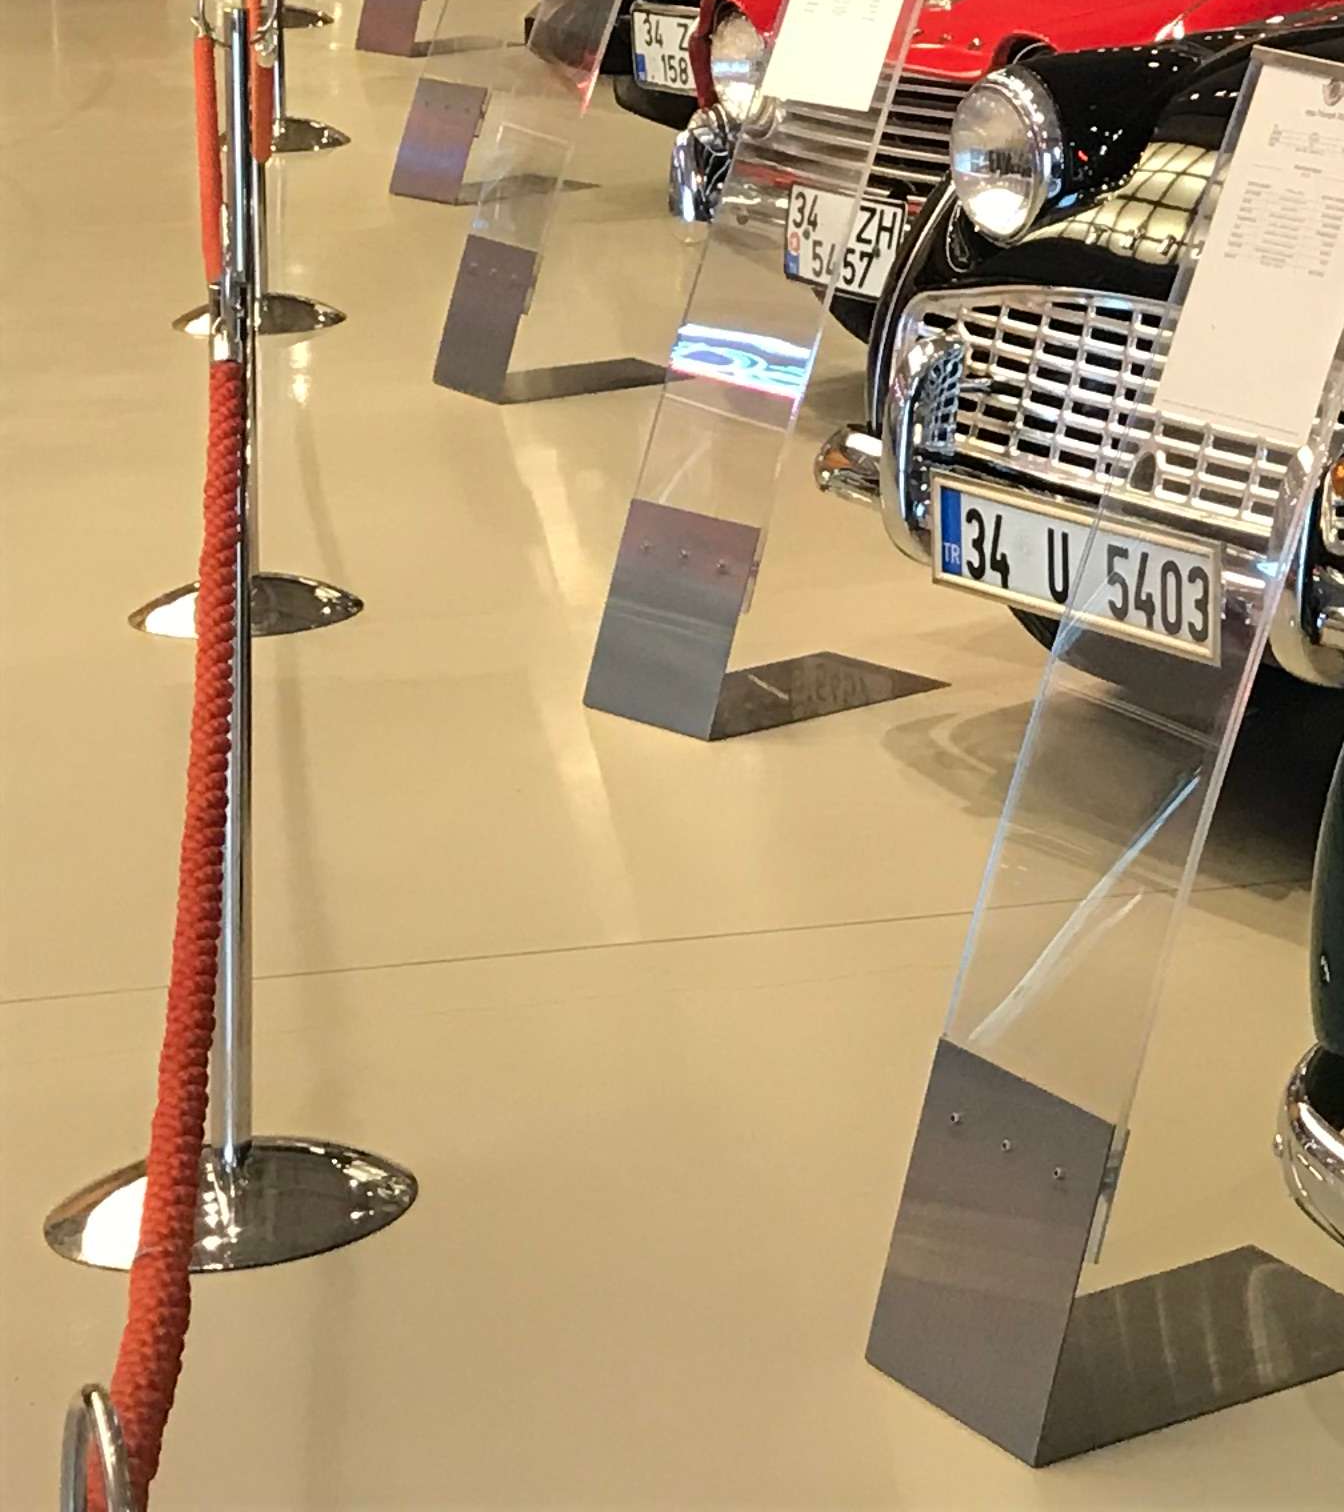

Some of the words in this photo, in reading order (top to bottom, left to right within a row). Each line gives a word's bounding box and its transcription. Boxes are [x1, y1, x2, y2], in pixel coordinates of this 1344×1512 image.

[643, 14, 664, 48] 34
[661, 53, 689, 85] 158
[793, 191, 818, 232] 34
[856, 205, 897, 250] ZH
[943, 541, 961, 565] TR
[966, 508, 1010, 589] 34
[1048, 527, 1069, 604] U
[1107, 543, 1210, 642] 5403
